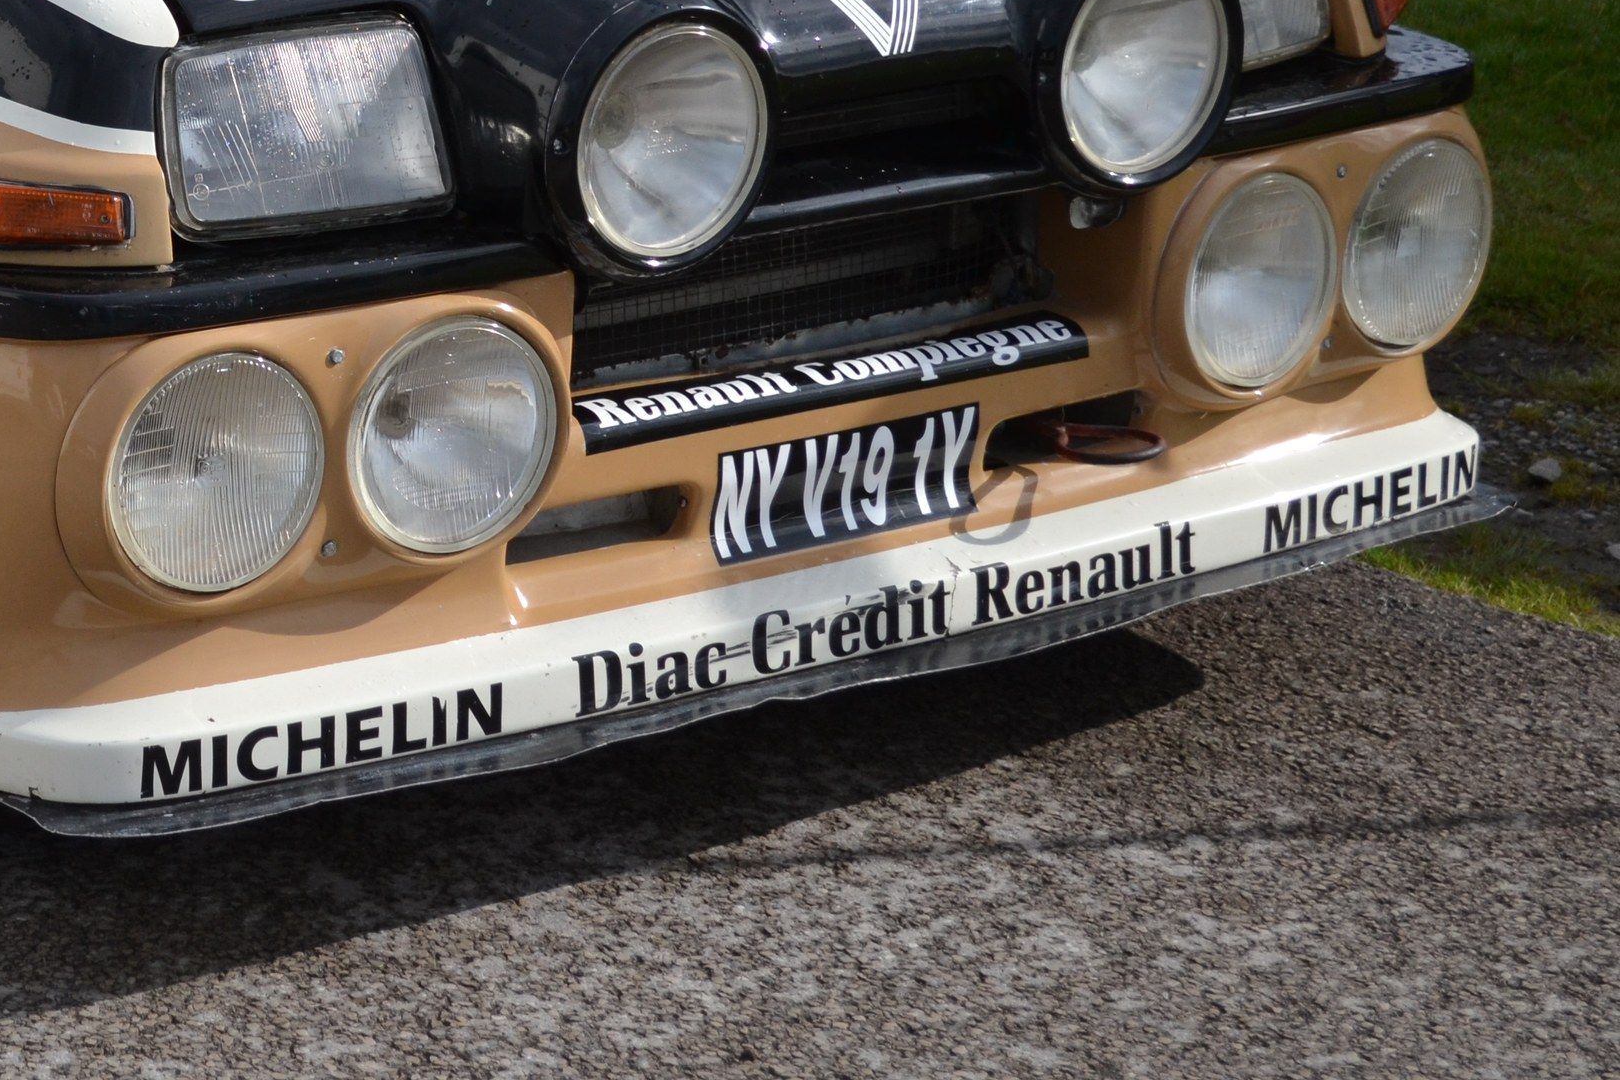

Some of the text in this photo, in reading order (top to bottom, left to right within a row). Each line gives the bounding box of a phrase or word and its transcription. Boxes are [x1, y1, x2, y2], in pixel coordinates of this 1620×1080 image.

[574, 371, 799, 429] Renault
[139, 682, 503, 799] MICHELIN
[570, 642, 728, 718] Diac
[971, 518, 1197, 625] Renault
[1263, 443, 1478, 554] MICHELIN
